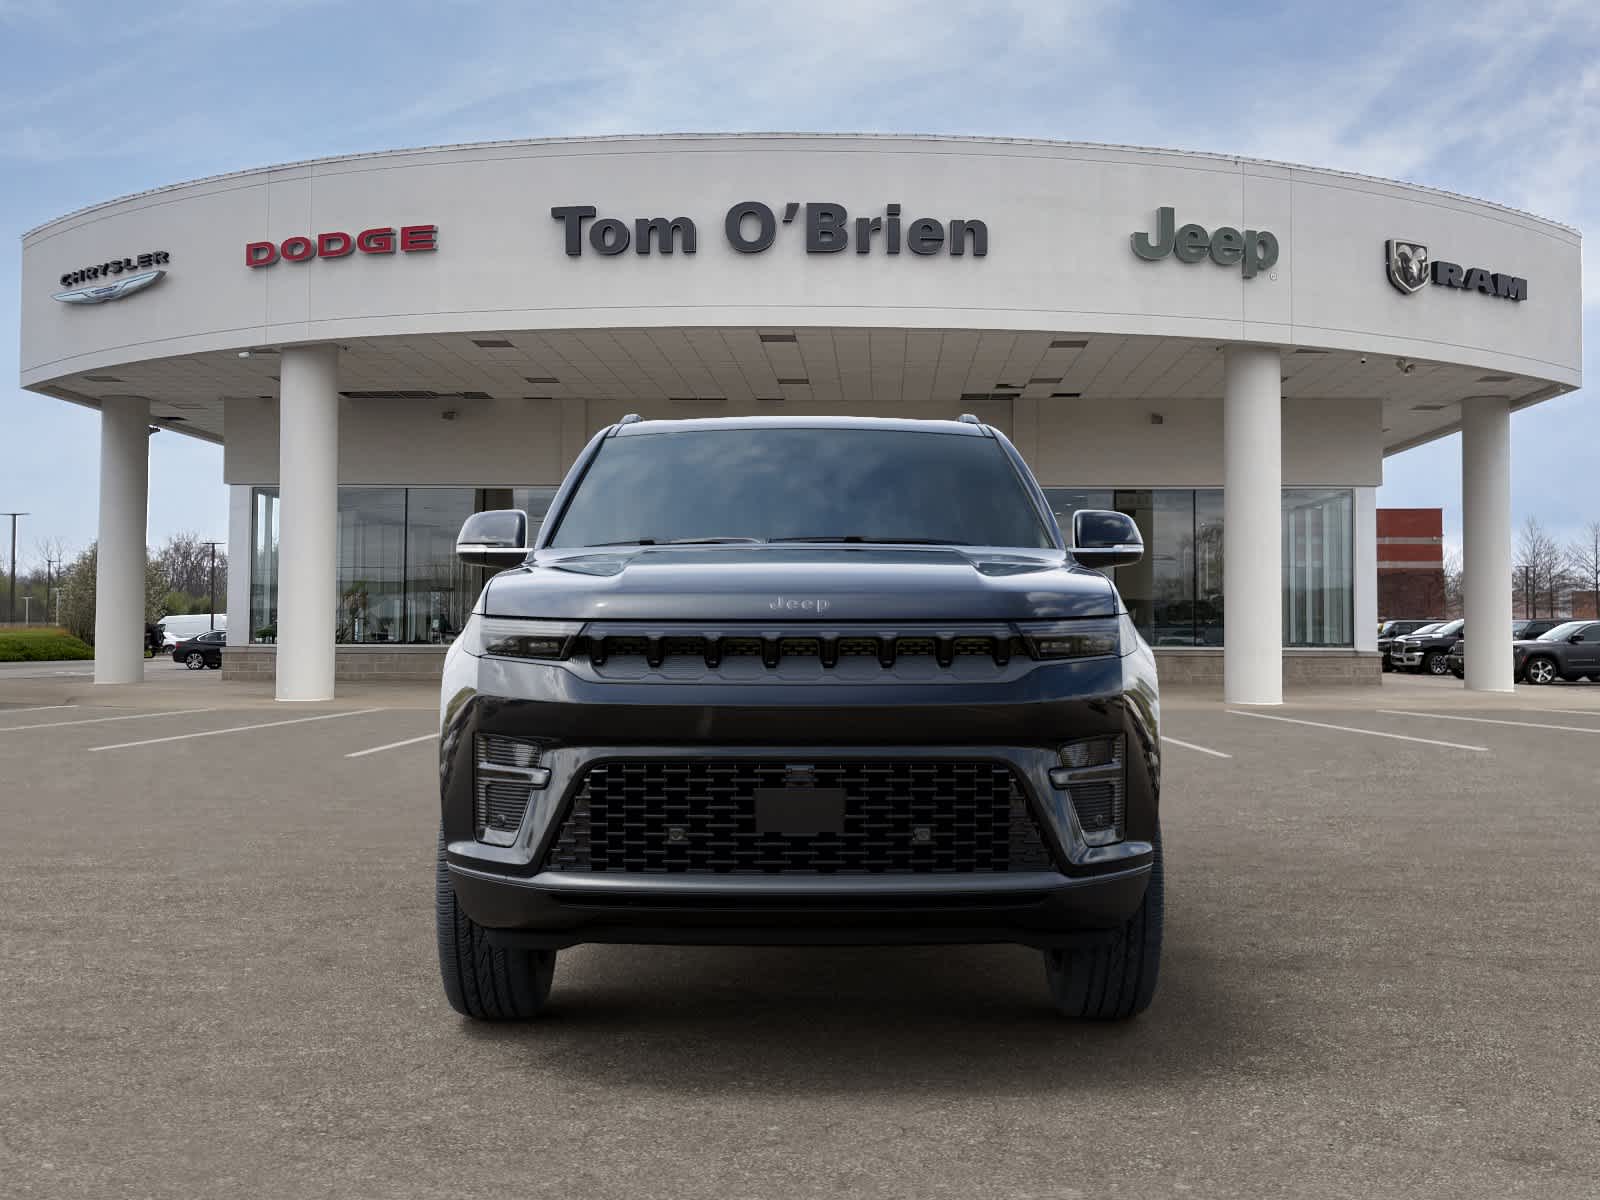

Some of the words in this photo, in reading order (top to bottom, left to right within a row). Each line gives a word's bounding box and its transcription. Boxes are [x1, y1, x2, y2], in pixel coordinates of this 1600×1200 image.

[246, 224, 438, 268] DODGE
[551, 205, 696, 256] Tom
[725, 200, 988, 256] O'Brien
[1130, 206, 1279, 279] Jeep
[60, 250, 169, 286] CHRYSLER
[1431, 261, 1527, 301] RAM
